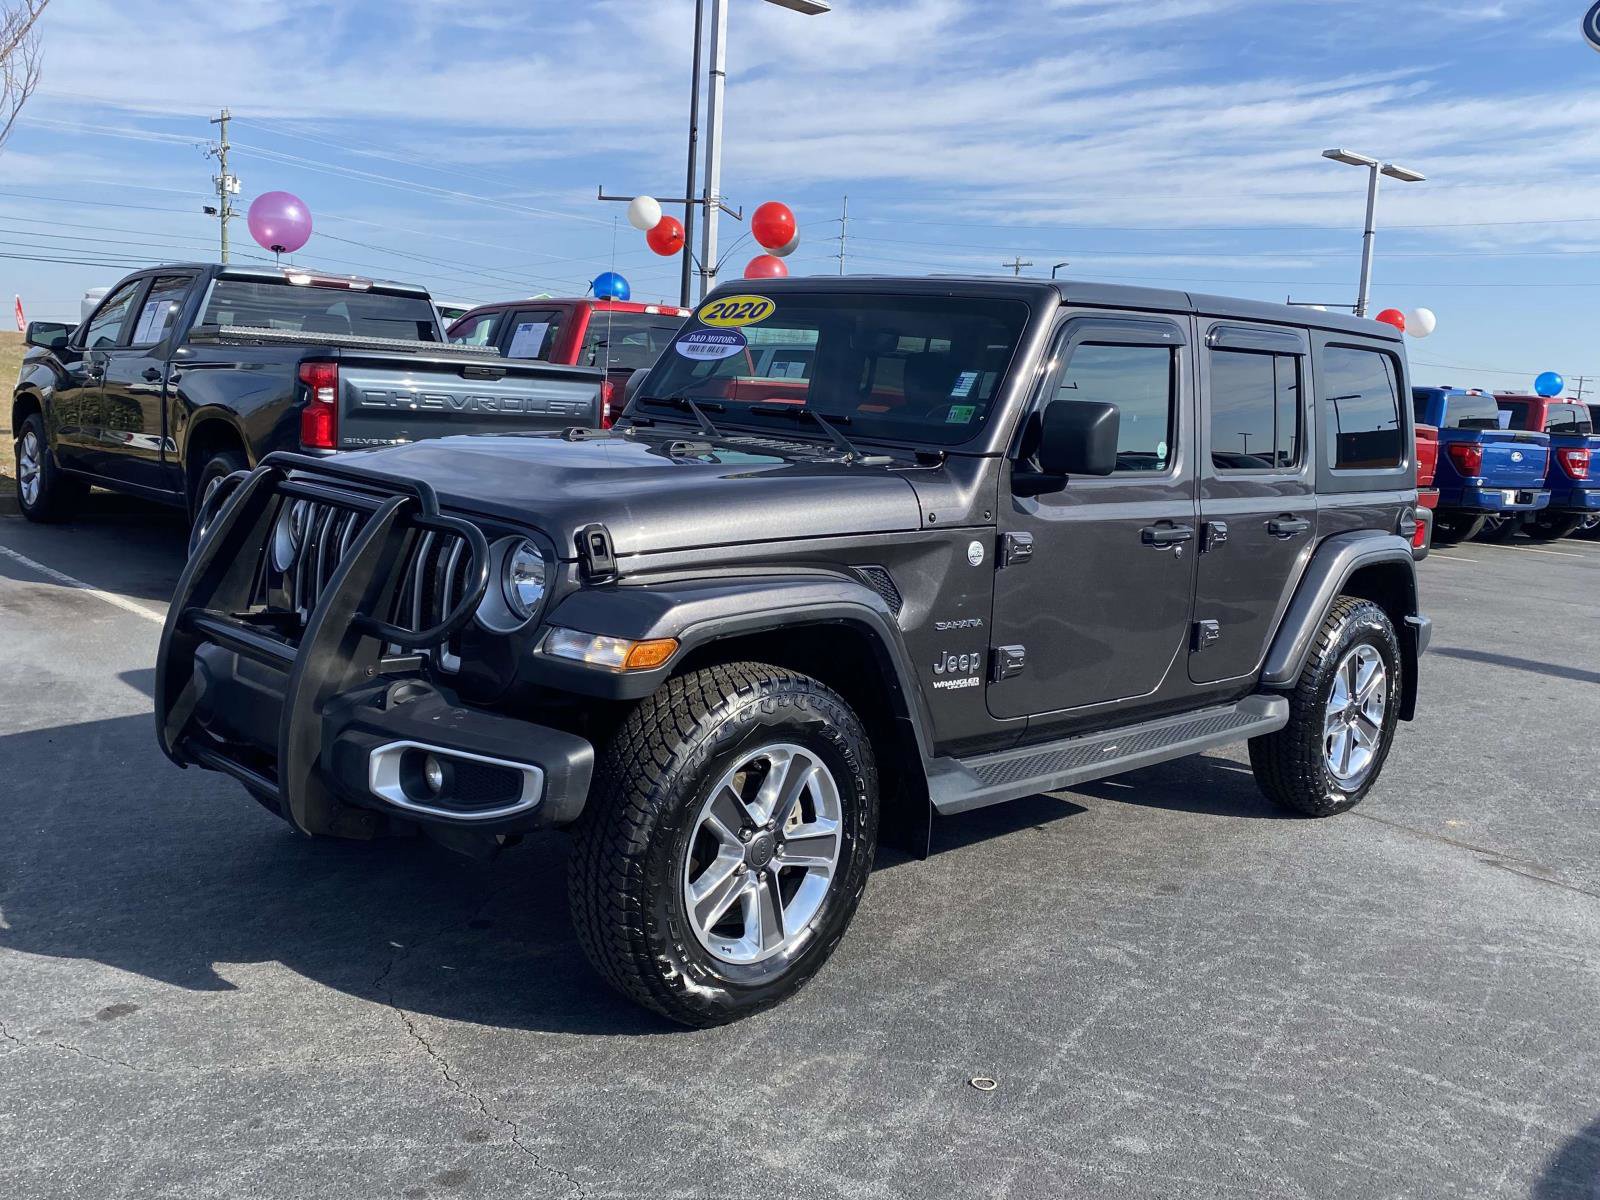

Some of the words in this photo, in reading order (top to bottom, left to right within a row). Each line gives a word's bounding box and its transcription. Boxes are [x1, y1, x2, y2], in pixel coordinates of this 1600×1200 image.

[704, 302, 769, 319] 2020
[689, 334, 706, 342] D&D
[707, 335, 737, 344] MOTORS
[687, 344, 707, 353] TRUE
[707, 345, 729, 354] BLUE
[361, 390, 588, 415] CHEVROLET
[935, 618, 983, 631] SAHARA
[933, 651, 981, 675] Jeep
[933, 677, 980, 689] WRANGLER
[818, 723, 868, 895] BRIDGESTON
